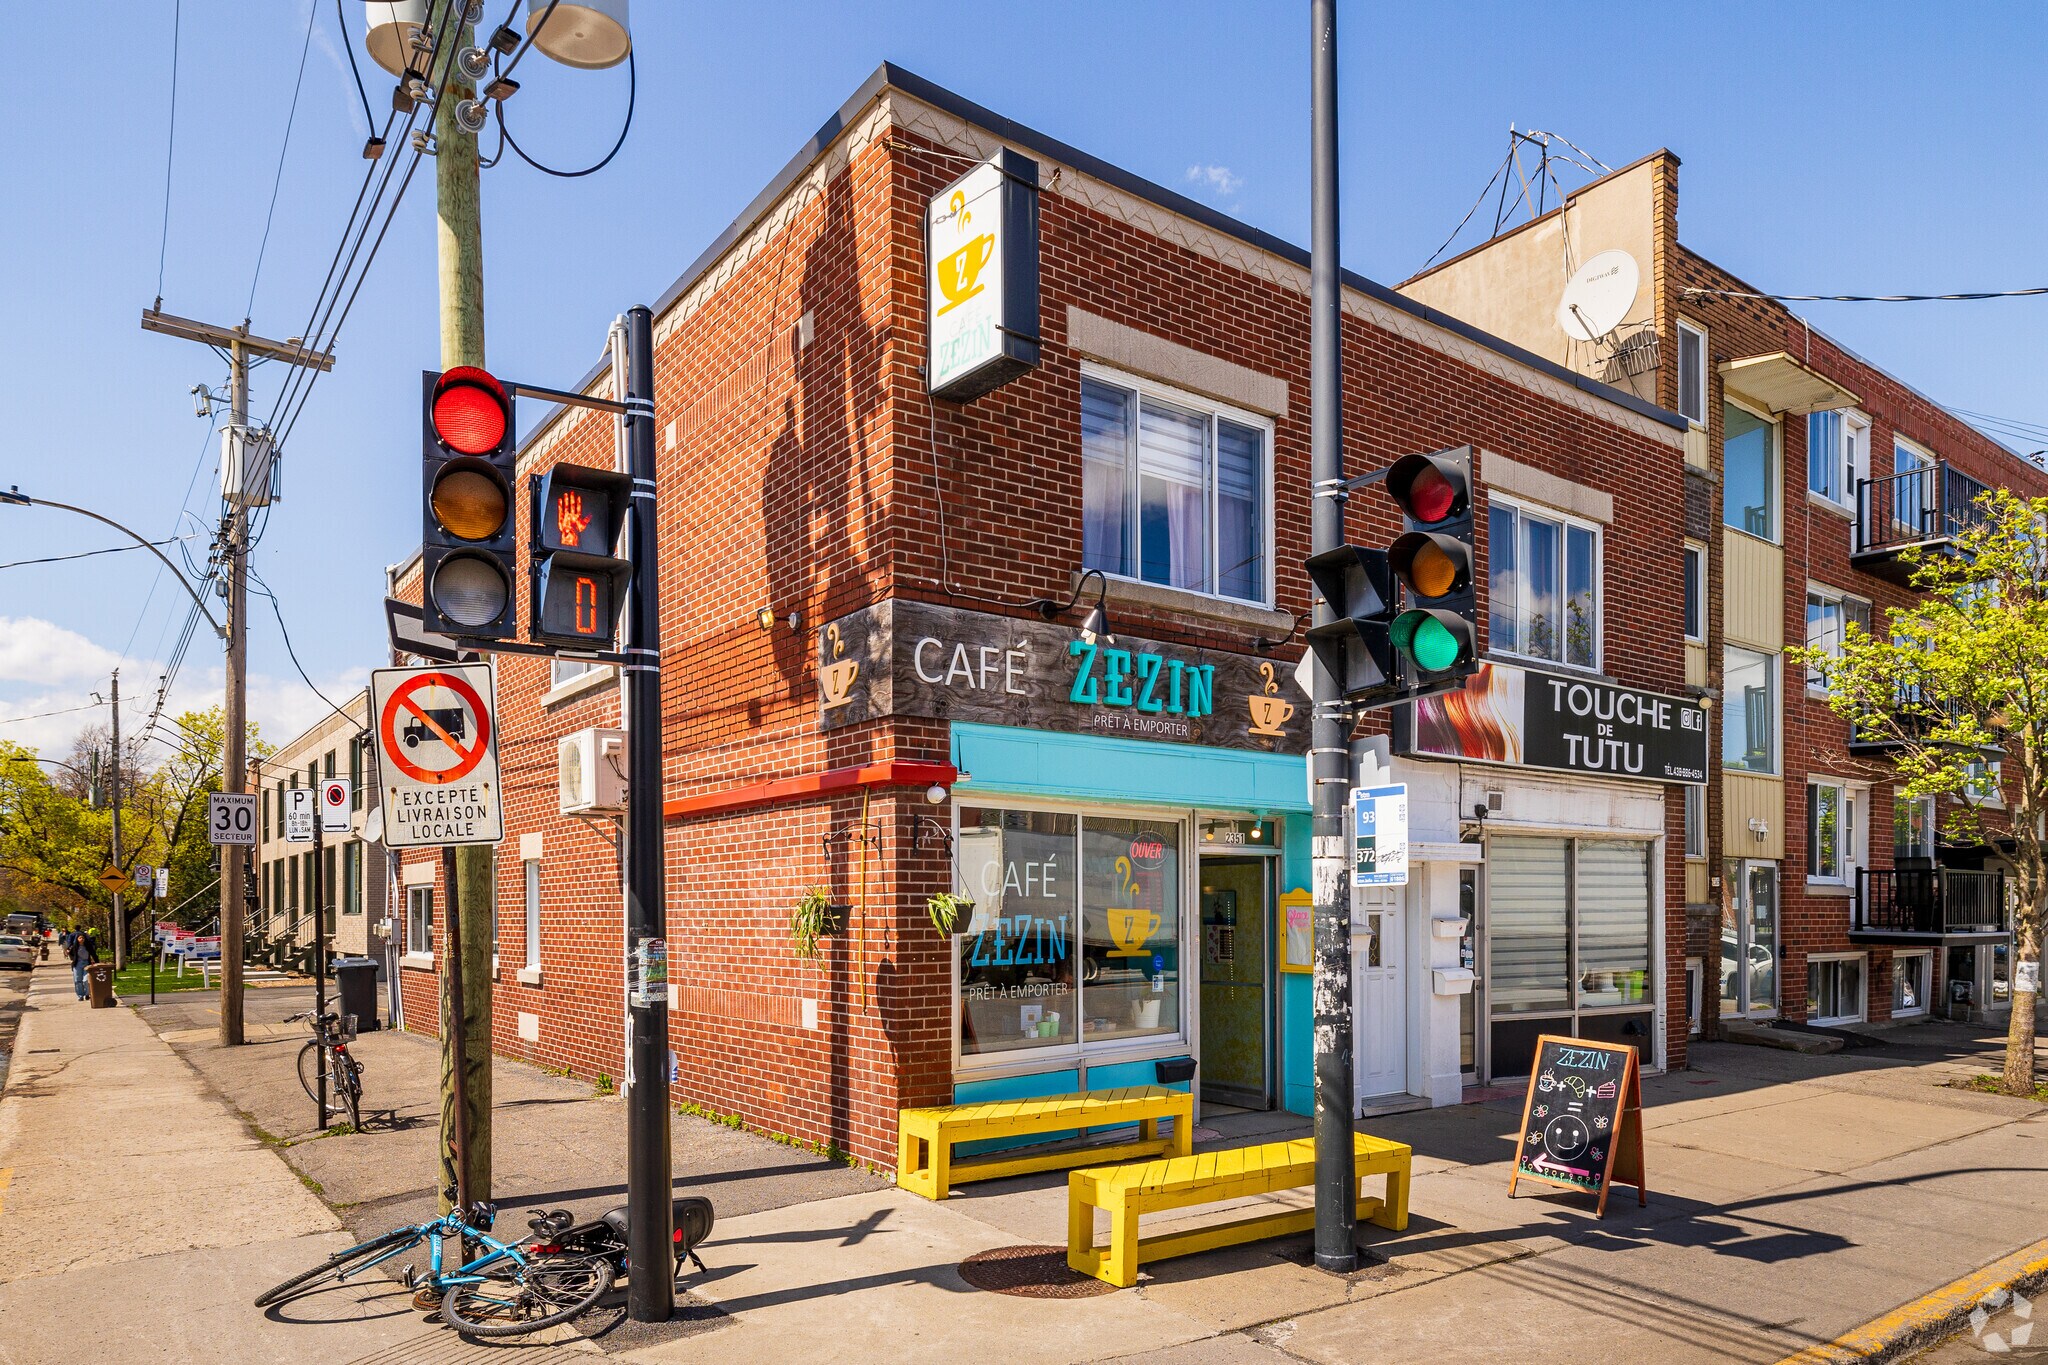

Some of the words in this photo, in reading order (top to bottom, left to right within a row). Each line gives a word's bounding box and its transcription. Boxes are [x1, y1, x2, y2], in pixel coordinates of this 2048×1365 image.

[956, 250, 968, 292] Z
[939, 314, 992, 377] ZEZIN
[576, 577, 596, 633] 0
[914, 637, 1026, 695] CAFÉ
[1069, 640, 1215, 718] ZEZIN
[1548, 679, 1671, 730] TOUCHE
[1094, 714, 1120, 729] PRÊT
[1123, 714, 1131, 730] À
[1133, 720, 1188, 737] EMPORTER
[1597, 723, 1613, 738] DE
[1563, 733, 1644, 773] TUTU
[213, 796, 253, 805] MAXIMUM
[294, 792, 304, 810] P
[403, 785, 478, 806] EXCEPTÉ
[215, 806, 251, 831] 30
[288, 812, 297, 820] 60
[299, 812, 310, 820] min
[397, 805, 487, 823] LIVRAISON
[1363, 812, 1375, 823] 93
[214, 832, 252, 841] SECTEUR
[412, 822, 475, 839] LOCALE
[1226, 833, 1244, 844] 2351
[1357, 850, 1376, 863] 372
[981, 853, 1057, 898] CAFÉ
[971, 912, 1067, 967] ZEZIN
[1125, 917, 1133, 943] Z
[969, 985, 997, 1001] PRÊT
[1000, 983, 1008, 999] À
[1010, 982, 1068, 1000] EMPORTER
[1556, 1047, 1611, 1071] ZEZIN
